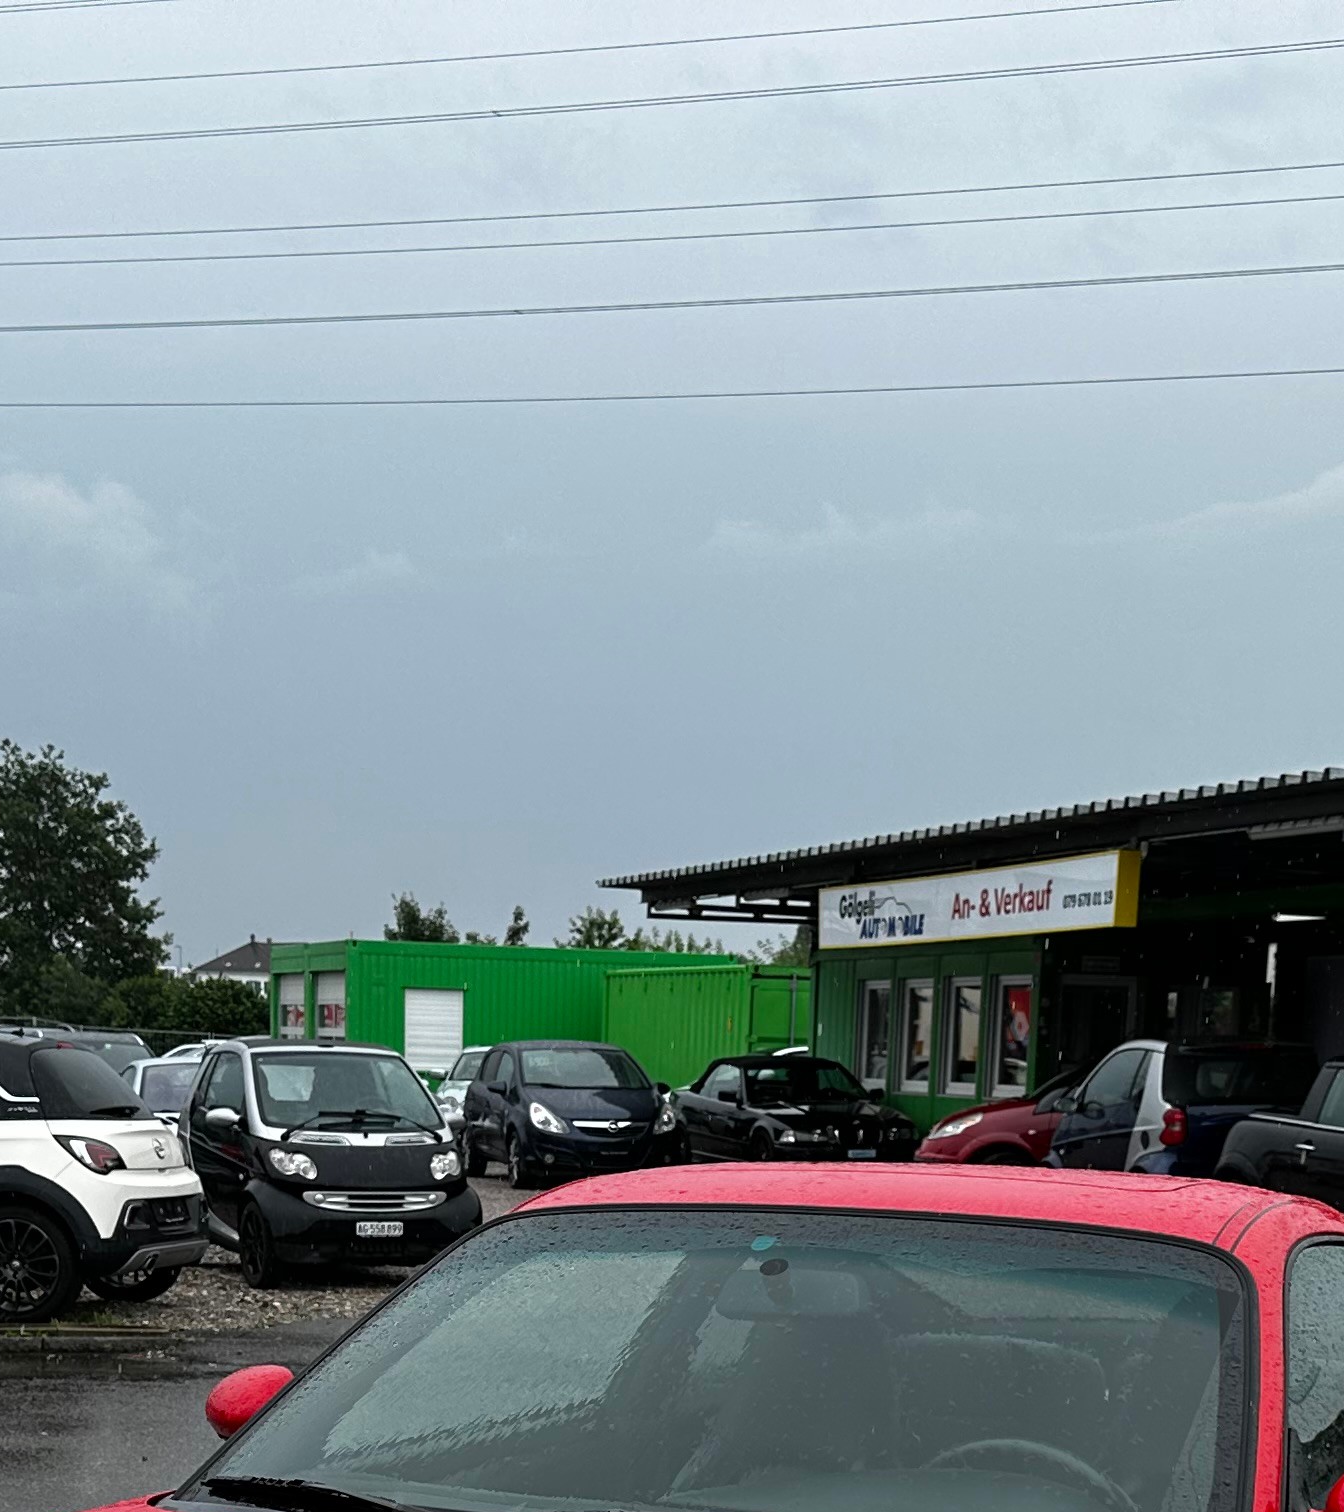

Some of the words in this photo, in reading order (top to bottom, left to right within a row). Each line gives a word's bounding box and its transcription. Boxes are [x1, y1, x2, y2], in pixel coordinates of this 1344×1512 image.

[839, 890, 876, 925] Gölgeli
[951, 893, 976, 921] An-
[979, 888, 991, 917] &
[994, 879, 1053, 915] Verkauf
[859, 913, 925, 939] AUTOMOBILE
